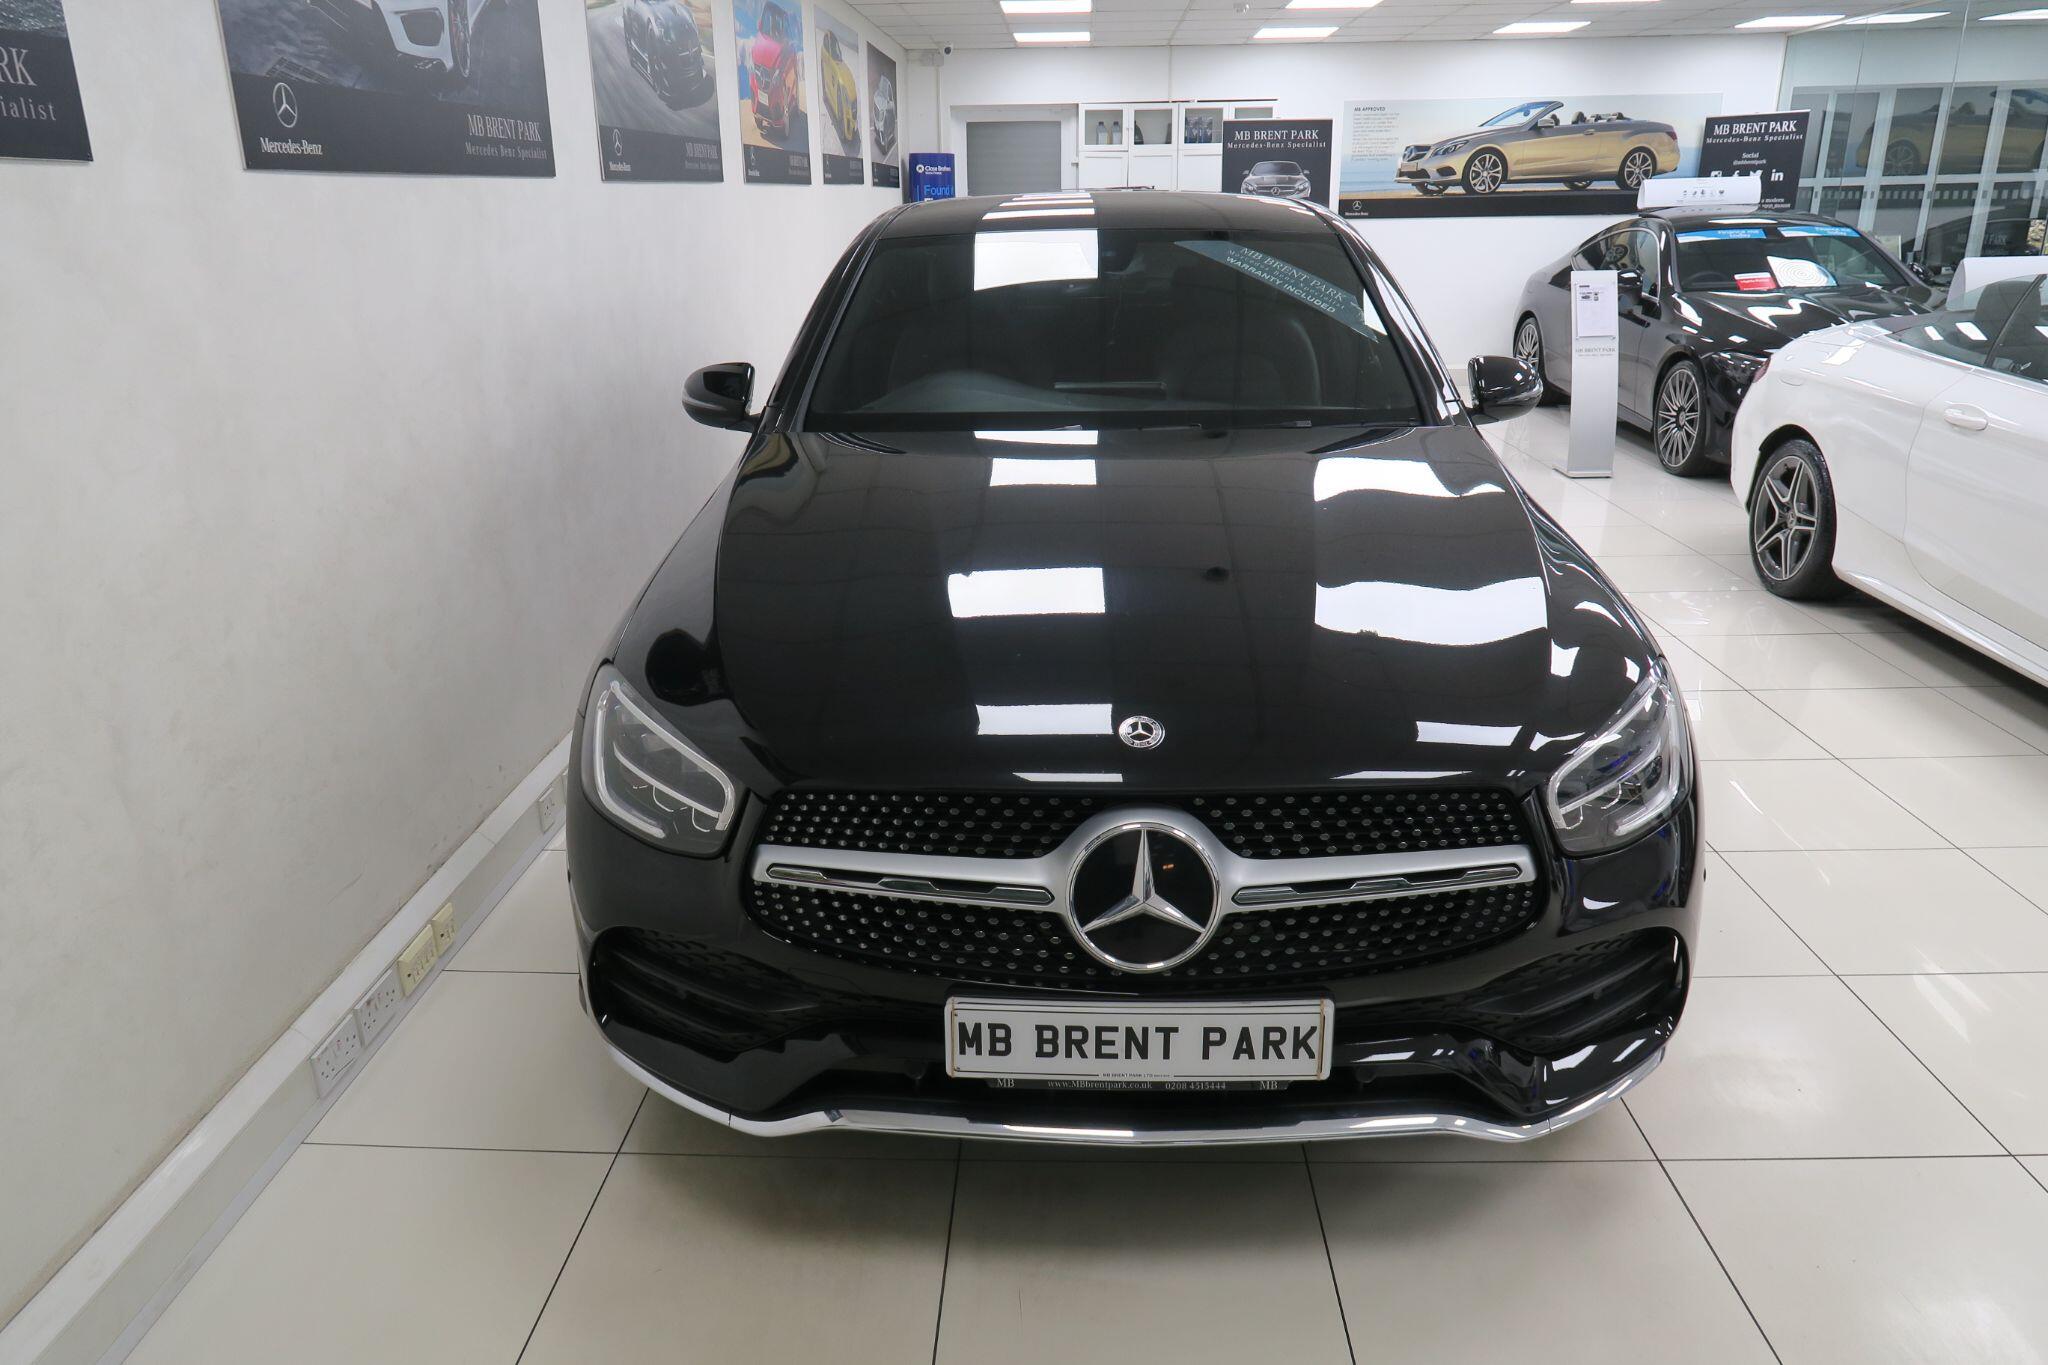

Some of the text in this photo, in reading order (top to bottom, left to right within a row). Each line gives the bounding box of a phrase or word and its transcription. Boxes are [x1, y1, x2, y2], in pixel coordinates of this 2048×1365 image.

[467, 114, 542, 141] MB BRENT PARK
[1234, 130, 1319, 140] MB BRENT PARK
[1714, 120, 1797, 135] MB BRENT PARK
[260, 137, 322, 155] Mercedes-Benz
[1706, 134, 1803, 144] Mercedes-Benz Specialist
[924, 184, 950, 196] Found
[1240, 248, 1344, 300] MB BRENT PARK
[1226, 256, 1336, 312] WARRANTY INCLUDED
[958, 1022, 1317, 1060] MB BRENT PARK
[998, 1079, 1278, 1090] MB www.MBbrentpark.co.uk 0208 4515444 MB
